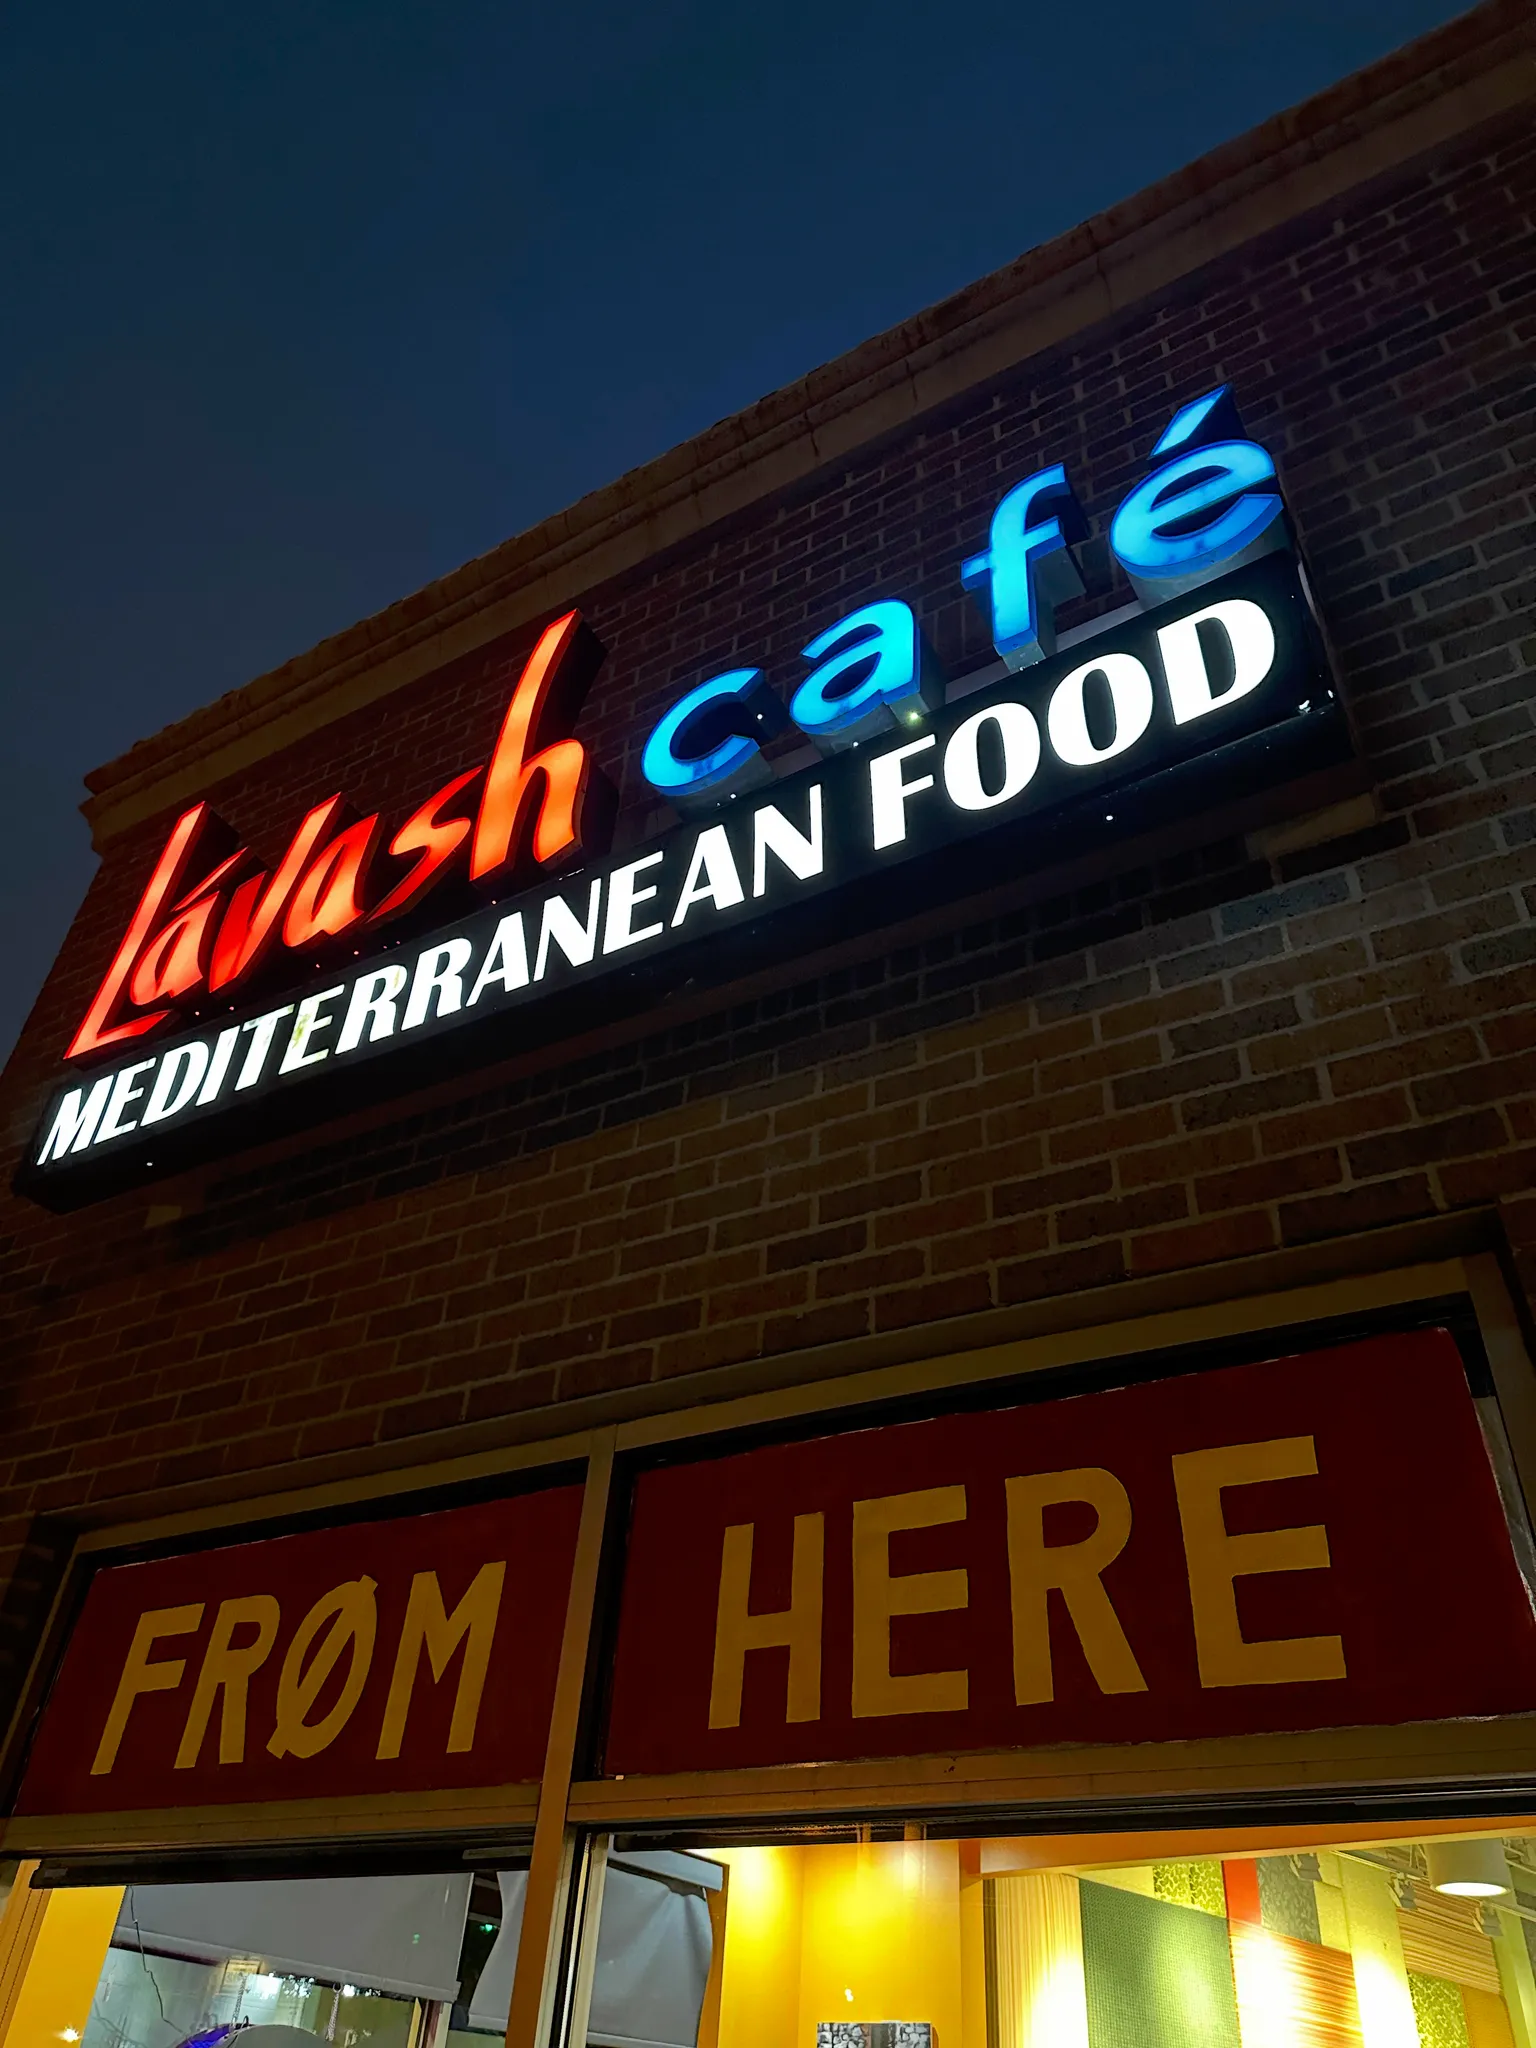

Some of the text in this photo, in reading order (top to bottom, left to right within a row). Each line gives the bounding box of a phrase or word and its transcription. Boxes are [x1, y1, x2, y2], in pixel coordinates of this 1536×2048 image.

[36, 599, 1276, 1165] MEDITERRANEAN FOOD
[64, 383, 1284, 1060] Lávash café
[708, 1435, 1347, 1729] HERE
